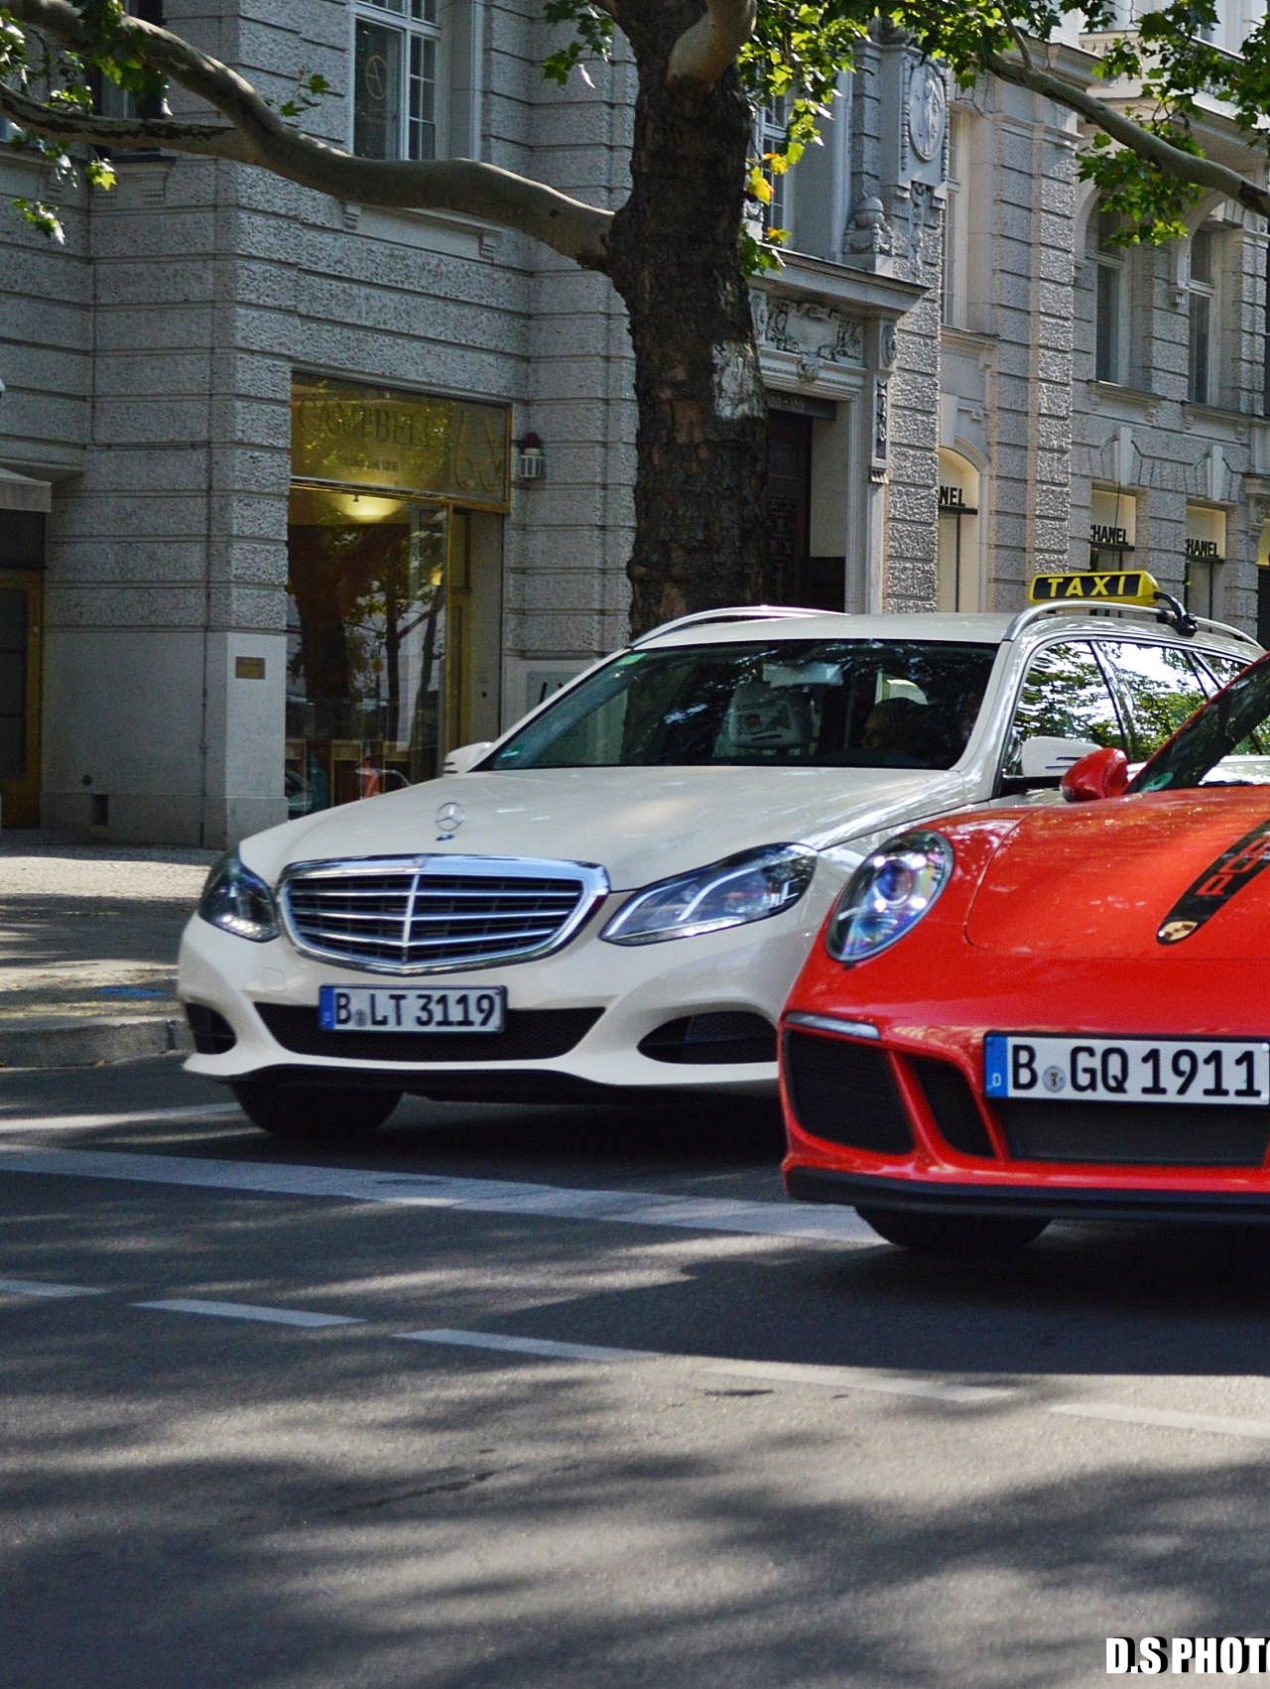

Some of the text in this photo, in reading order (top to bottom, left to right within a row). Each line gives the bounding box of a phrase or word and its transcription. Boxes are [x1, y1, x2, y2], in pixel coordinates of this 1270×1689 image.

[937, 486, 965, 507] NEL
[1048, 576, 1126, 598] TAXI
[336, 992, 496, 1027] B LT 3119
[1012, 1044, 1262, 1098] B GQ 1911
